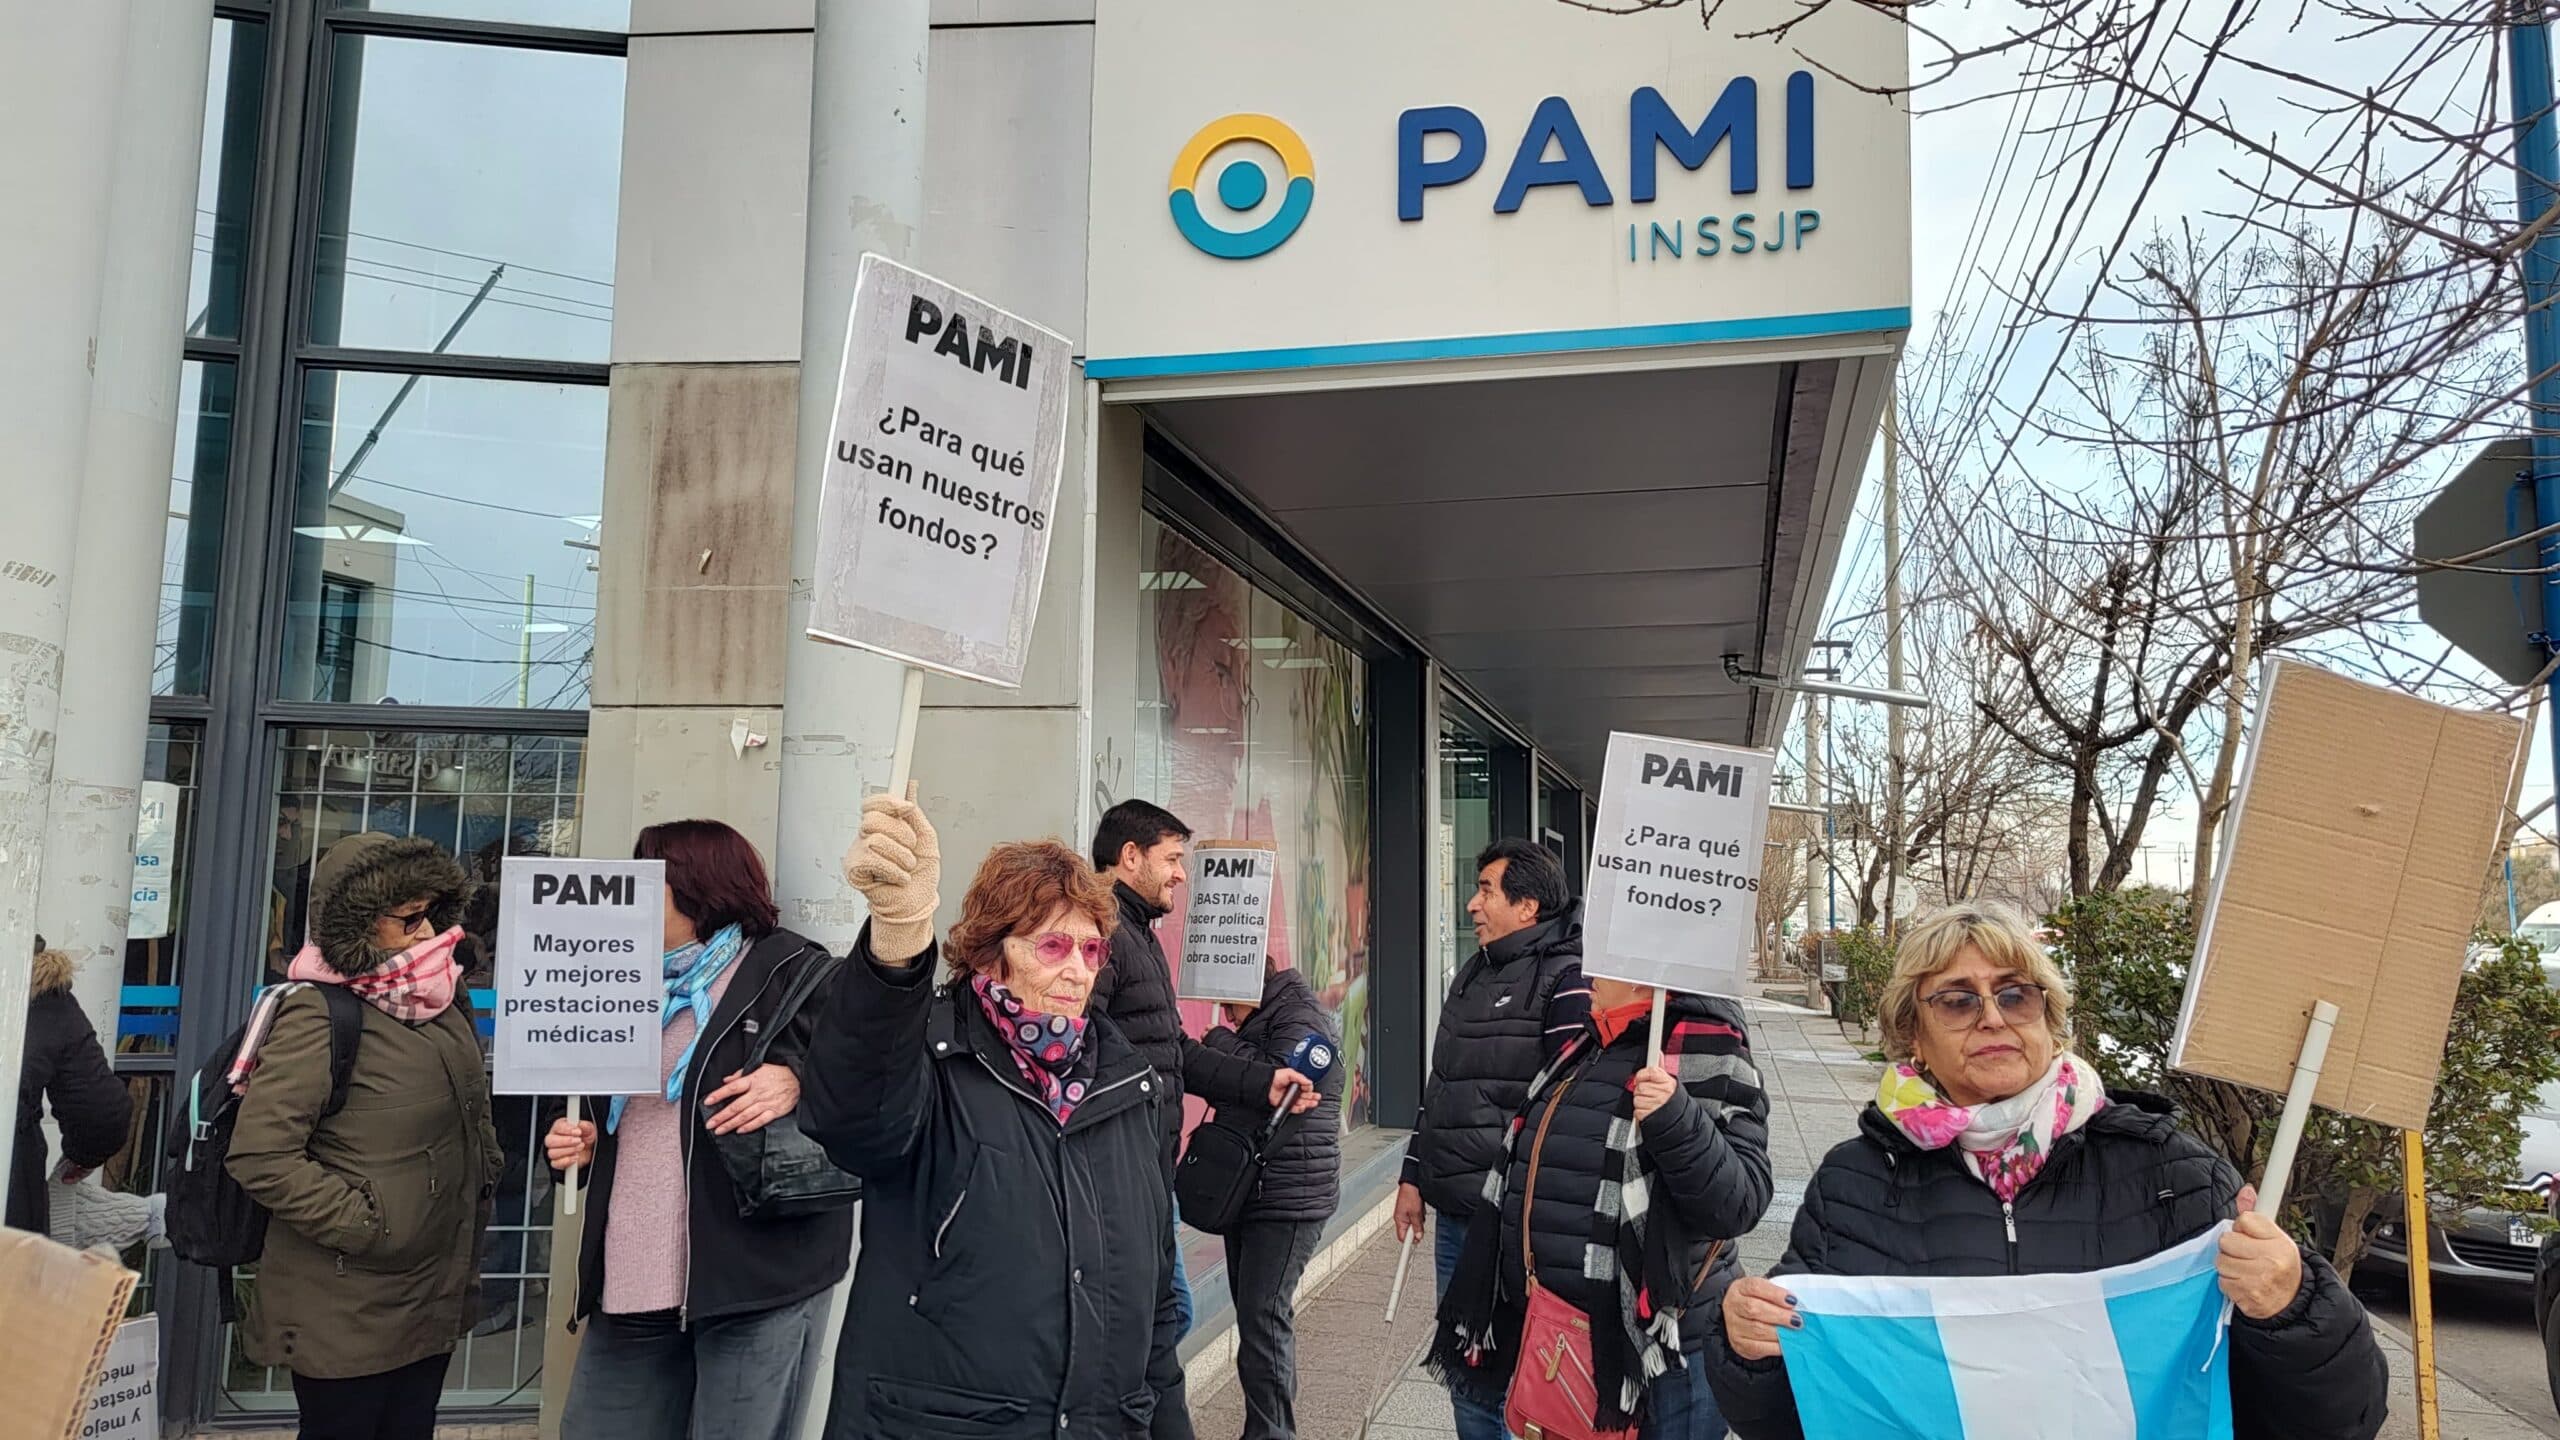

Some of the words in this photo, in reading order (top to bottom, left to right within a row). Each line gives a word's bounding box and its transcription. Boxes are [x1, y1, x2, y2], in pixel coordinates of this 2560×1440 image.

[1398, 70, 1815, 222] PAMI
[1629, 208, 1821, 263] INSSJP
[905, 294, 1034, 390] PAMI
[878, 405, 963, 456] ¿Para
[970, 443, 1026, 477] qué
[836, 440, 914, 483] usan
[921, 470, 1046, 531] nuestros
[877, 496, 999, 560] fondos?
[1641, 753, 1744, 798] PAMI
[1624, 825, 1691, 851] ¿Para
[1698, 839, 1741, 858] qué
[1203, 857, 1255, 879] PAMI
[1597, 853, 1652, 875] usan
[1659, 862, 1760, 892] nuestros
[532, 874, 636, 906] PAMI
[1193, 892, 1241, 908] ¡BASTA!
[1243, 893, 1260, 906] de
[1626, 885, 1723, 917] fondos?
[1218, 912, 1265, 928] política
[533, 933, 635, 957] Mayores
[1188, 933, 1207, 944] con
[1210, 933, 1258, 945] nuestra
[1186, 951, 1210, 964] obra
[1213, 952, 1256, 966] social!
[523, 968, 538, 987] y
[545, 964, 642, 988] mejores
[504, 994, 660, 1017] prestaciones
[527, 1024, 635, 1043] médicas!
[131, 1407, 142, 1425] y
